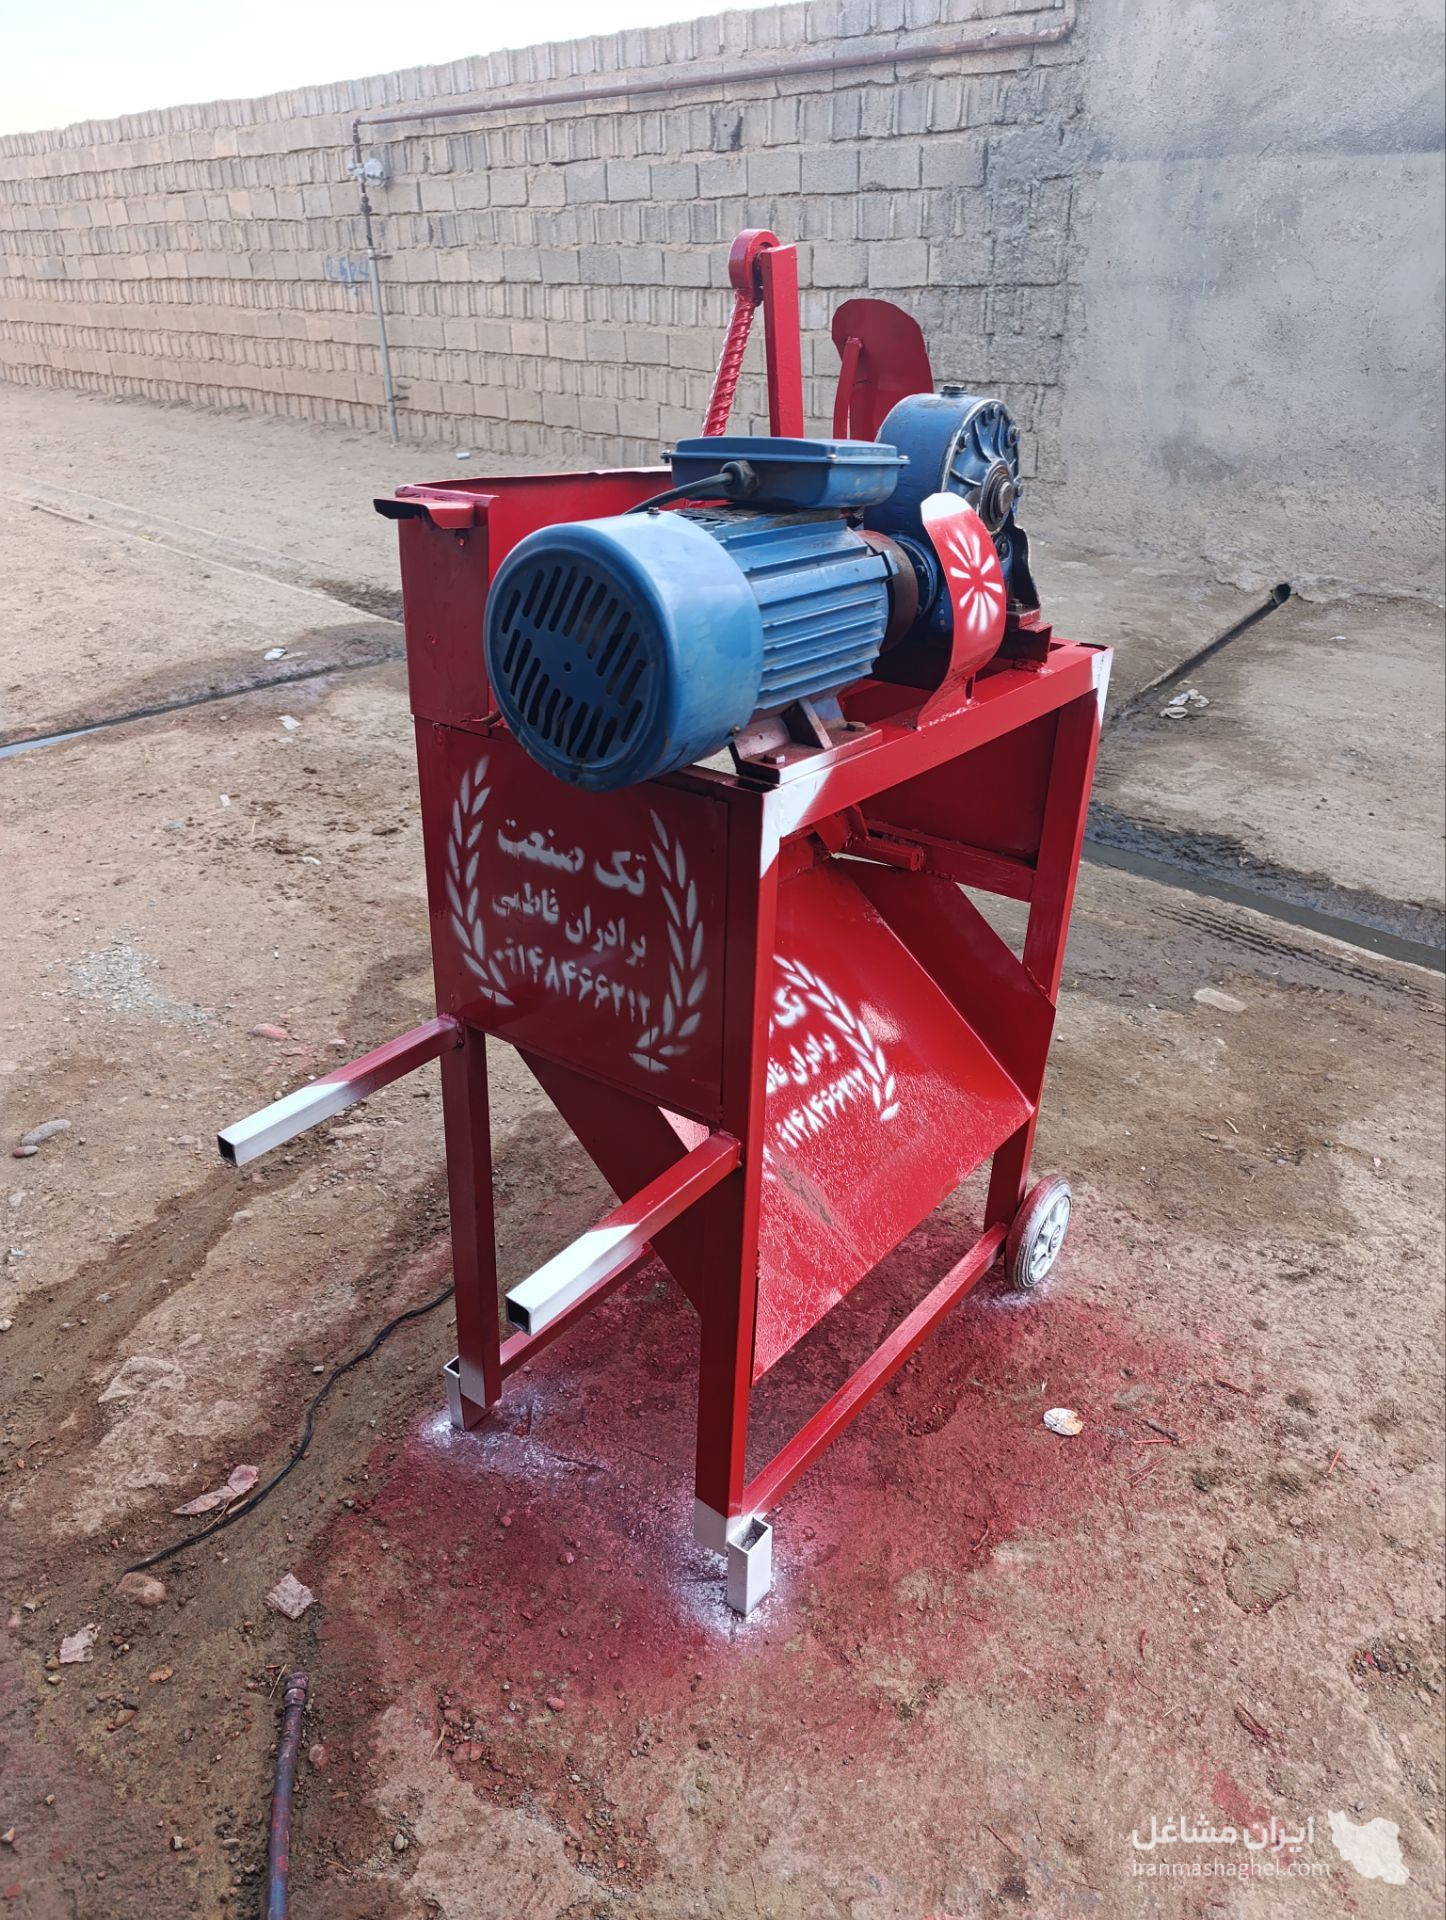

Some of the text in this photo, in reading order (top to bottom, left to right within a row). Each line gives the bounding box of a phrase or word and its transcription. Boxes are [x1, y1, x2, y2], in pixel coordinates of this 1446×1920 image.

[497, 818, 648, 895] تک صنعت
[492, 882, 647, 967] برادران فاطمی
[774, 985, 807, 1027] تک
